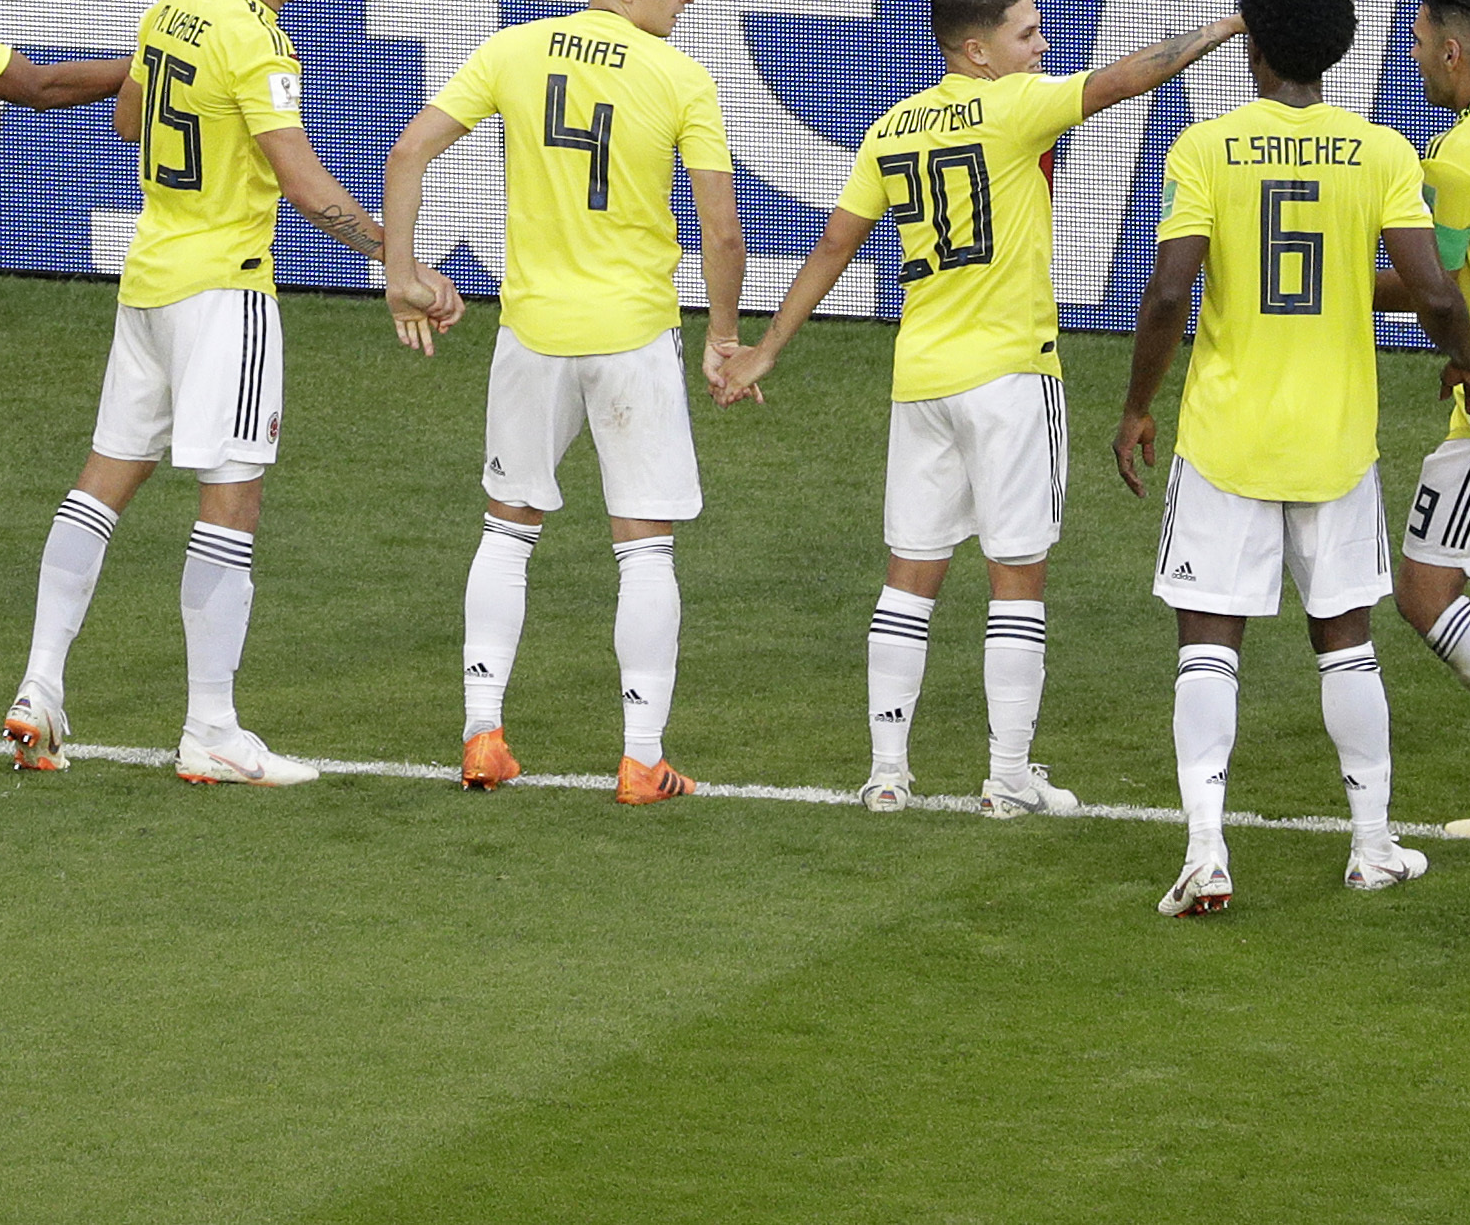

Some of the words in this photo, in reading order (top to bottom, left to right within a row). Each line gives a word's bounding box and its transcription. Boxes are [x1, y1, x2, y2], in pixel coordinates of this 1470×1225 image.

[547, 31, 630, 69] ARIAS
[142, 43, 204, 193] 15
[543, 73, 615, 212] 4
[876, 97, 984, 140] J.QUINTERO
[1225, 136, 1364, 167] C.SANCHEZ
[876, 142, 995, 285] 20
[1259, 179, 1325, 316] 6
[1408, 483, 1441, 542] 9
